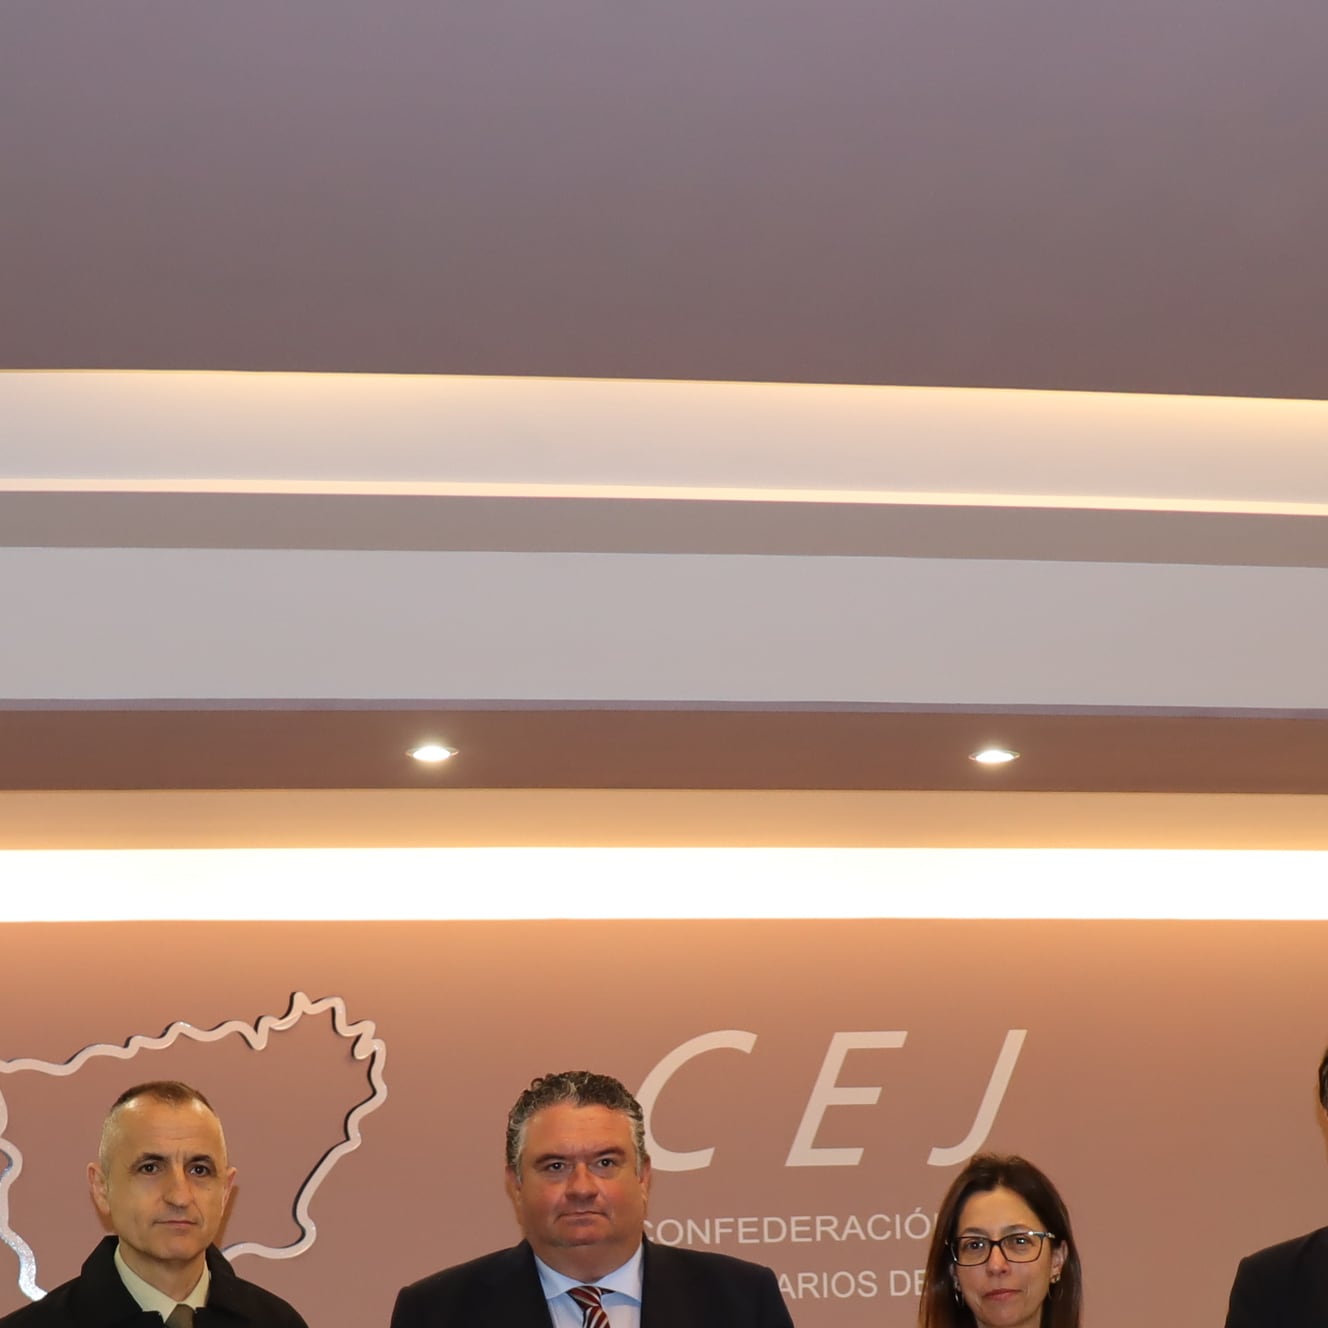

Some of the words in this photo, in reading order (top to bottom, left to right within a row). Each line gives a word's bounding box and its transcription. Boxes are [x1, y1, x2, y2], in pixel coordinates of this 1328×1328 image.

[634, 1029, 1028, 1172] CEJ
[643, 1207, 938, 1246] ONFEDERACIÓ
[778, 1270, 878, 1299] ARIOS
